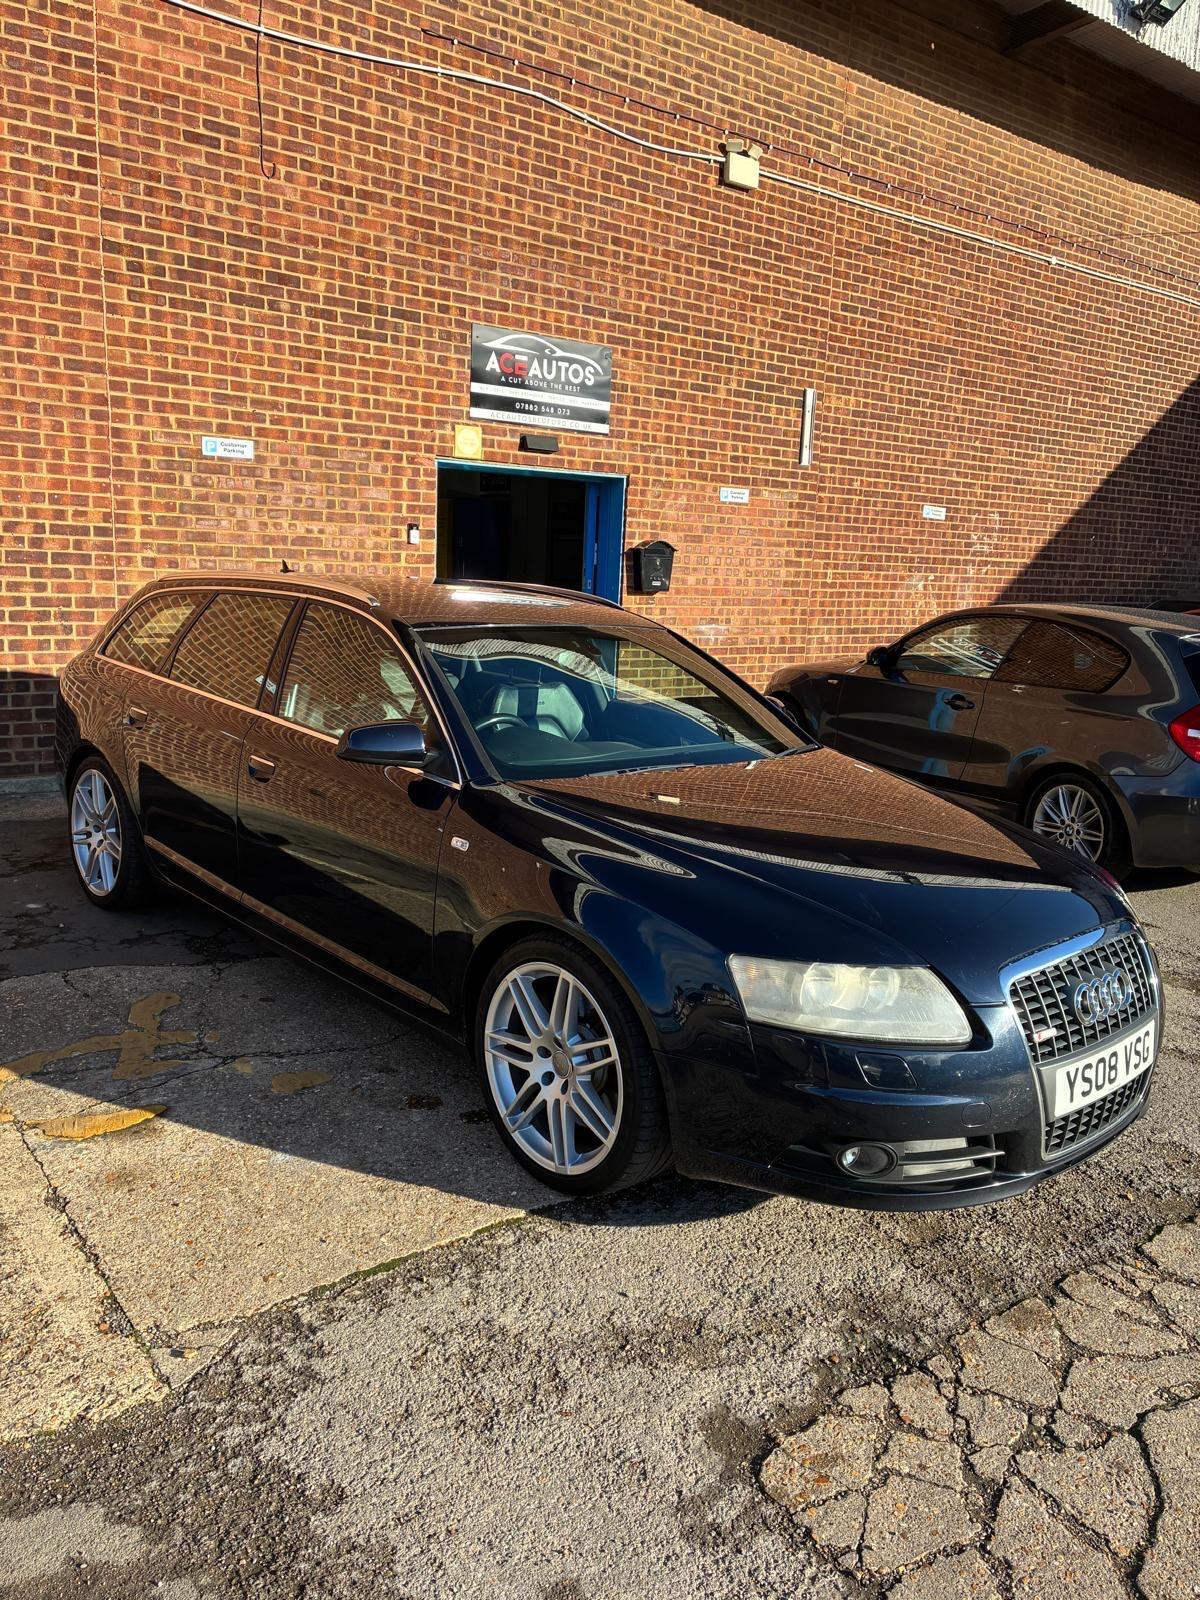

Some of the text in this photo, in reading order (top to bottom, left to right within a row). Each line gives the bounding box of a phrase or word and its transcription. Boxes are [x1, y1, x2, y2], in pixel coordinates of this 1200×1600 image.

[508, 376, 522, 384] CUT
[525, 379, 548, 388] ABOVE
[550, 382, 562, 391] THE
[564, 384, 580, 393] REST
[515, 402, 571, 416] 07882 548 073
[490, 411, 592, 430] ACEAUTOSBEDFORDCOUK
[223, 447, 245, 455] Parking
[1066, 1030, 1150, 1104] YS08 VSG
